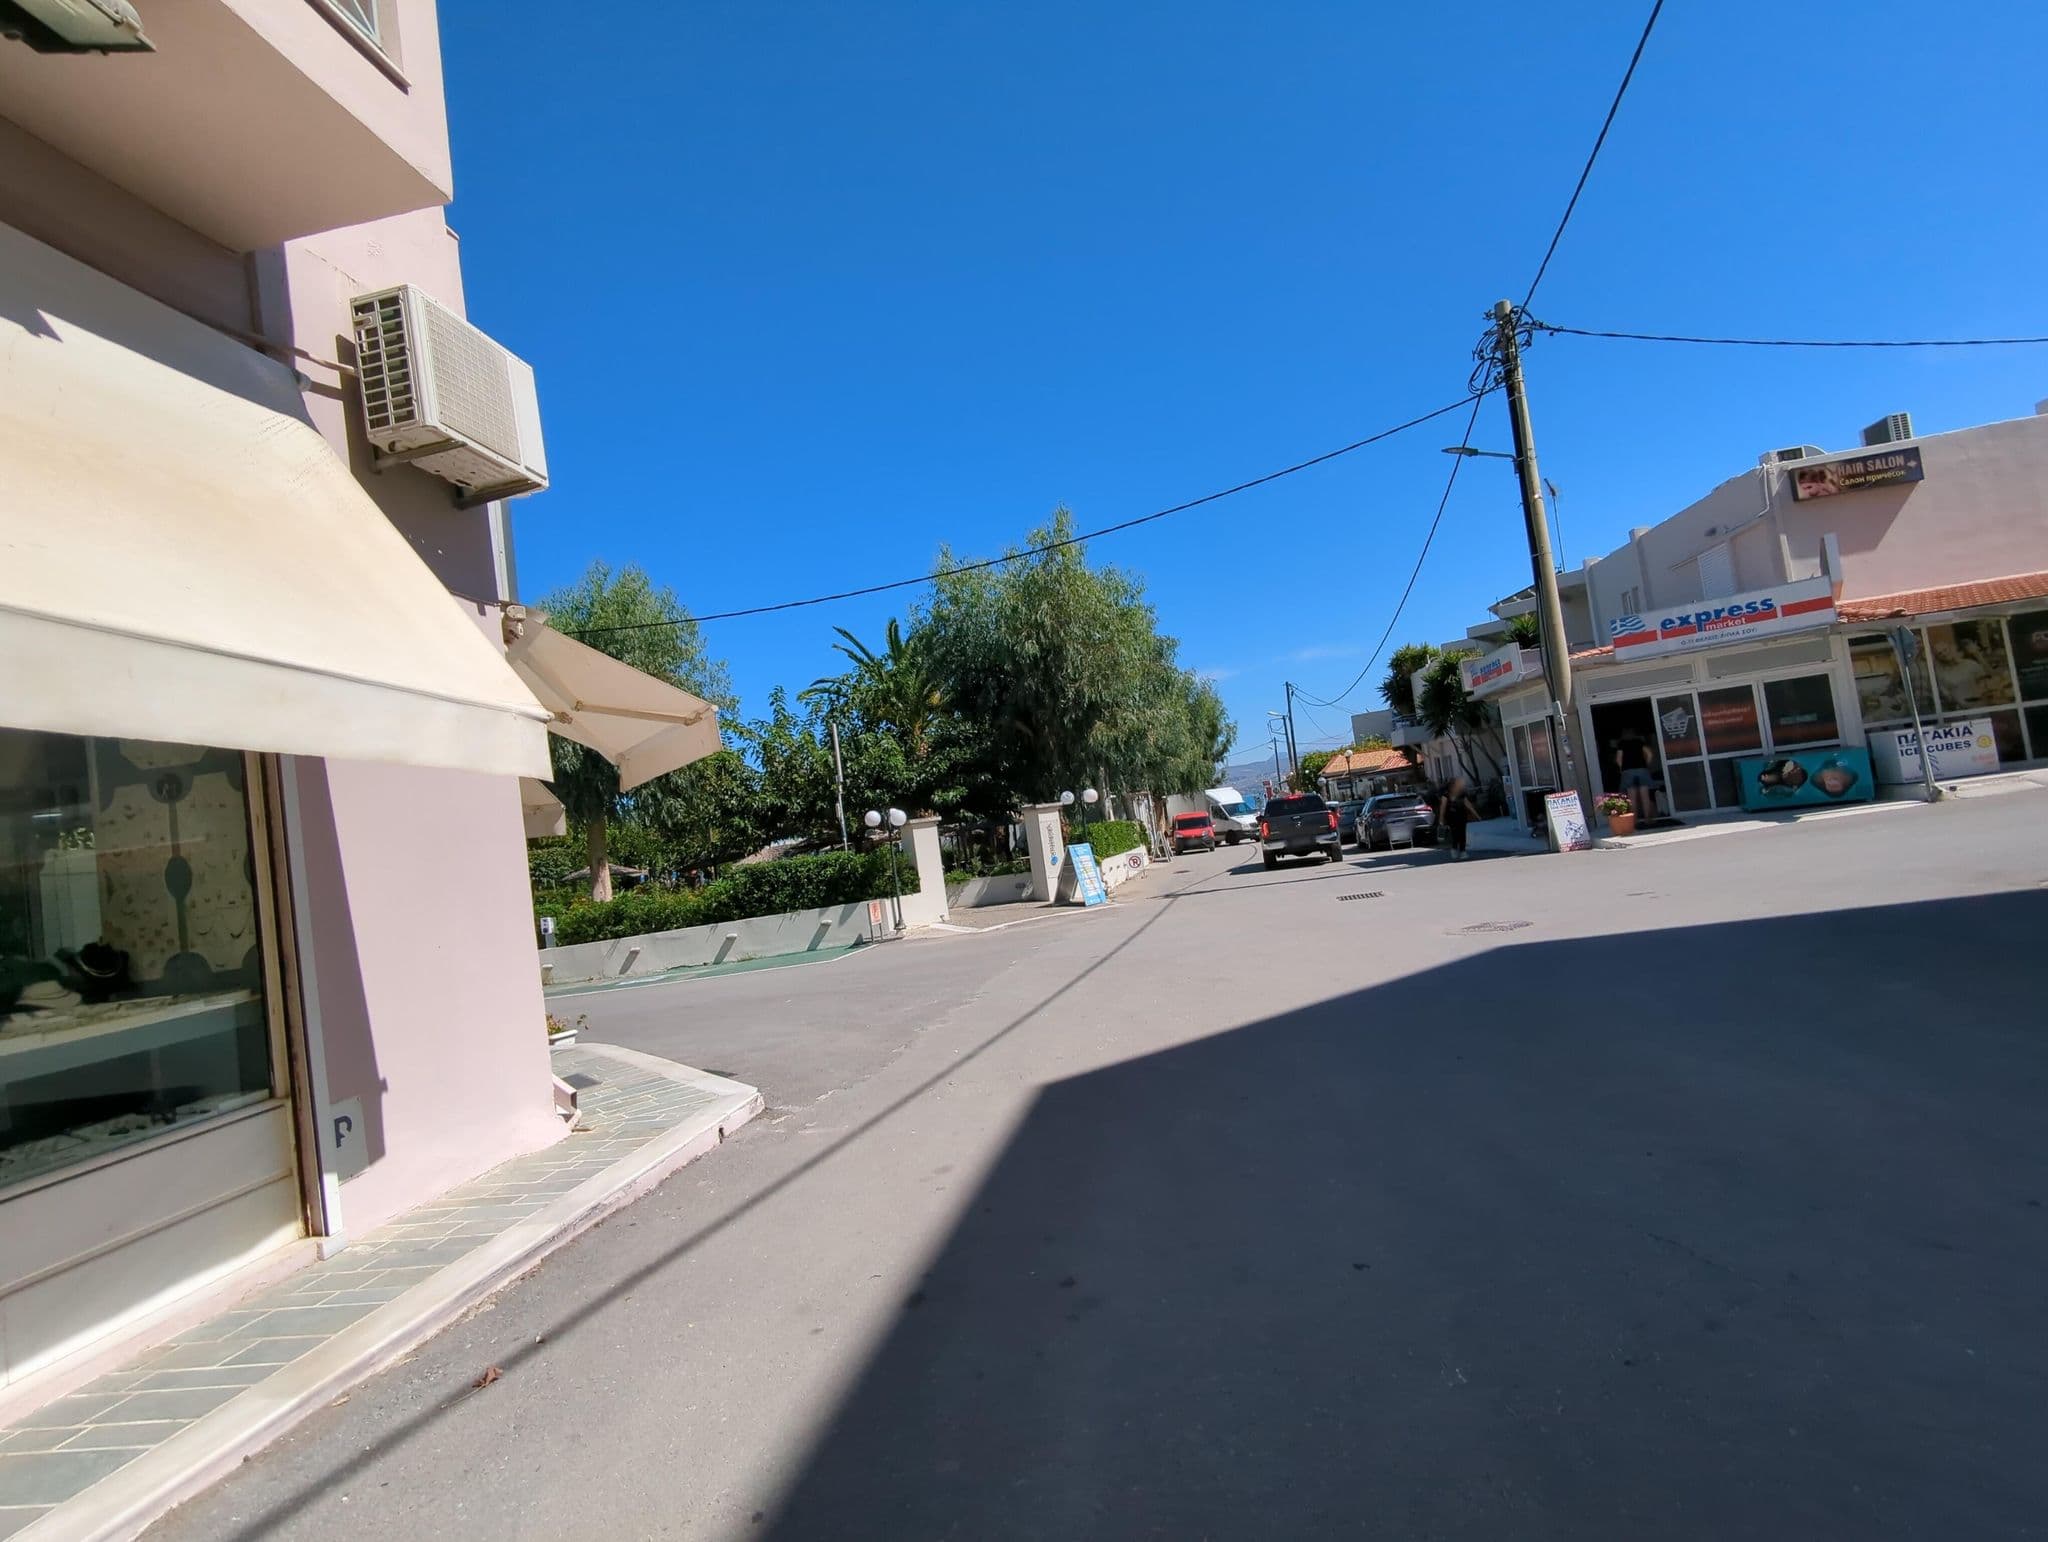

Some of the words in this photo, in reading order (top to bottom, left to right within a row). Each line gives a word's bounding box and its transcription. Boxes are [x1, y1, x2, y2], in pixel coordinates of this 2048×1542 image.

[1838, 461, 1864, 476] HAIR
[1866, 455, 1905, 472] SALON
[1839, 476, 1865, 487] Салон
[1660, 597, 1775, 632] express
[1705, 617, 1747, 632] market
[1926, 739, 1972, 754] CUBES
